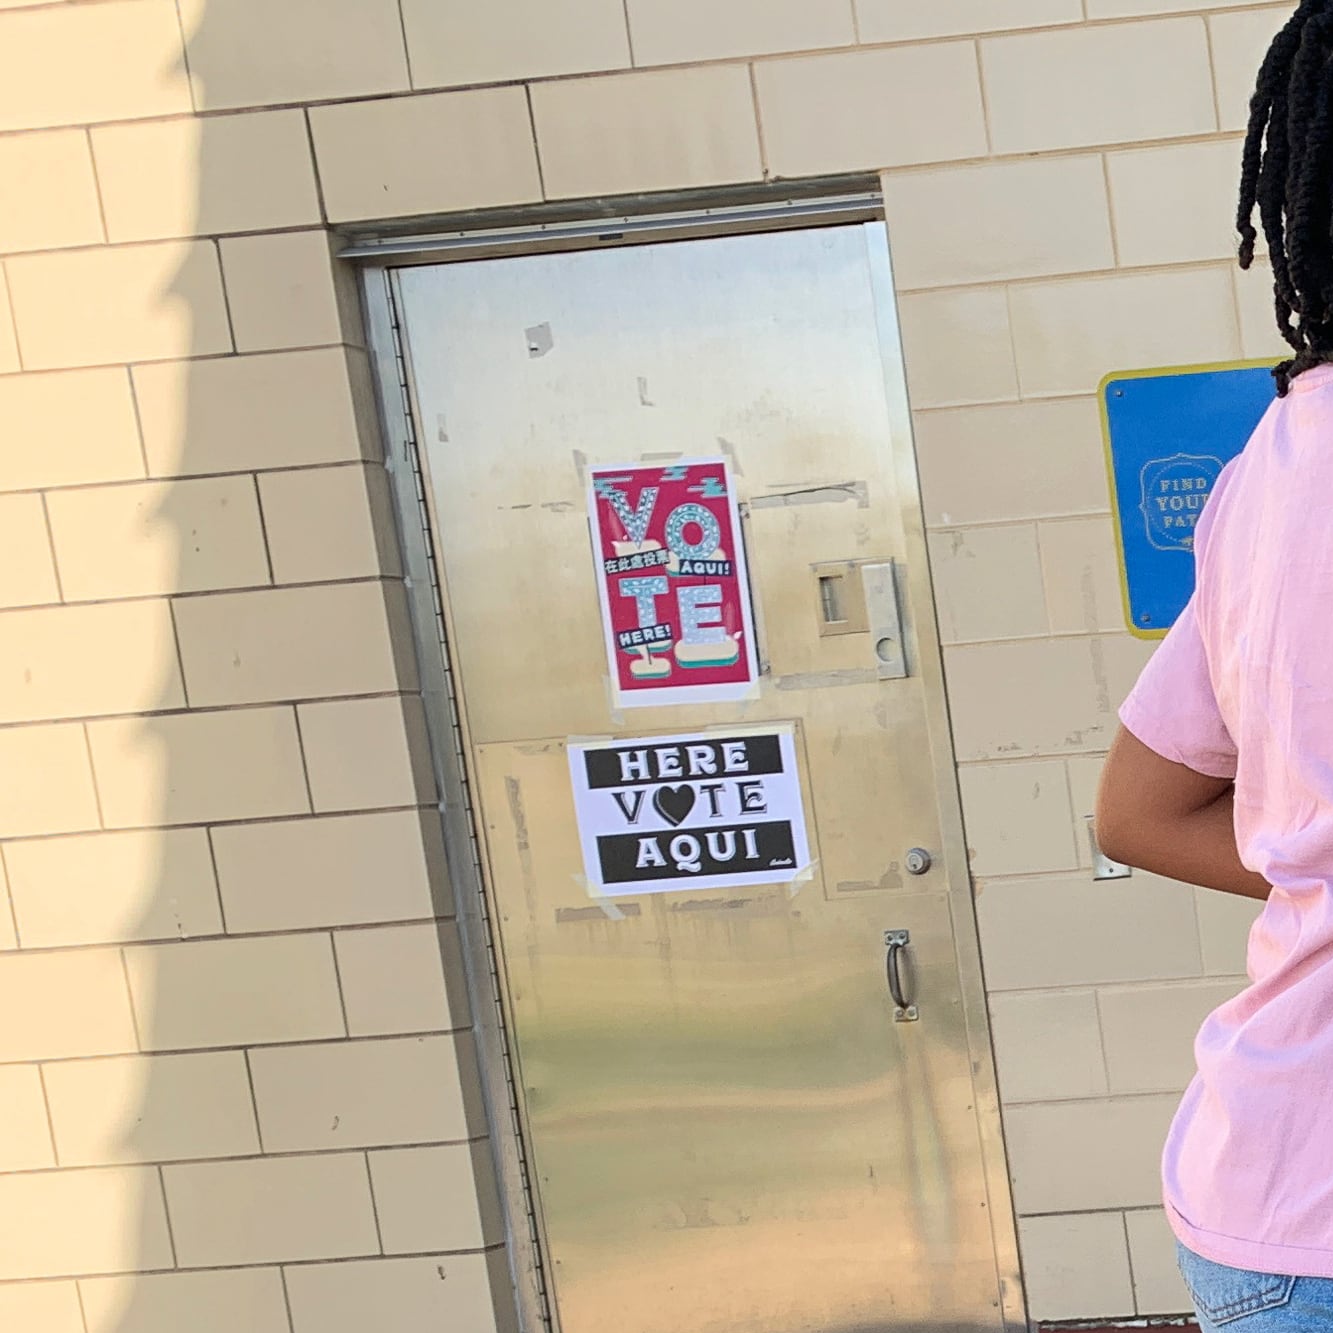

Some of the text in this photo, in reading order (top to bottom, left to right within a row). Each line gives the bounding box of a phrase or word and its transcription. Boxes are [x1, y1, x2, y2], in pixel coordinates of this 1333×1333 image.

[1160, 477, 1207, 492] FIND
[680, 561, 730, 575] AQUI!
[619, 625, 672, 647] HERE!
[617, 741, 749, 781] HERE
[636, 829, 760, 872] AQUI
